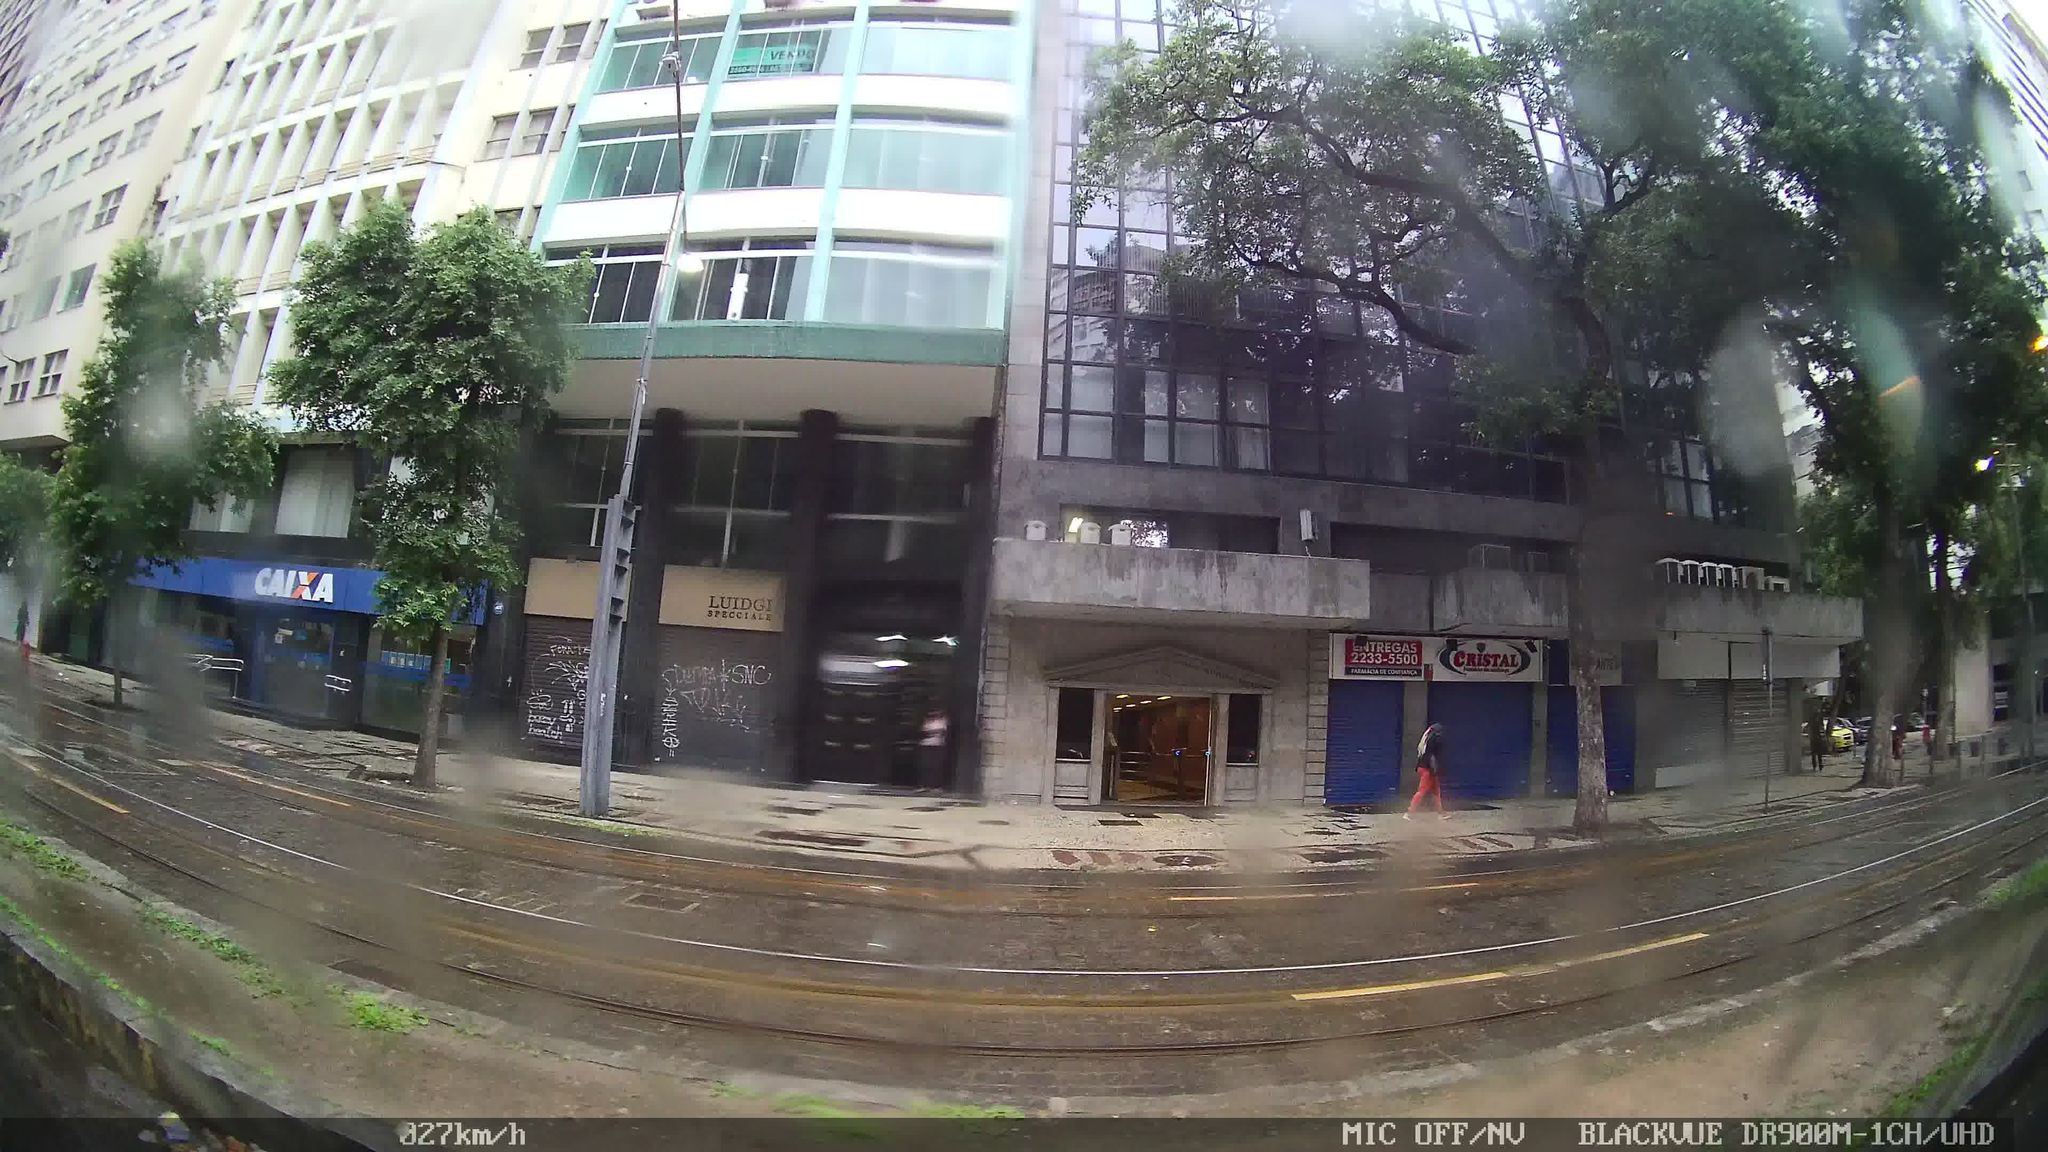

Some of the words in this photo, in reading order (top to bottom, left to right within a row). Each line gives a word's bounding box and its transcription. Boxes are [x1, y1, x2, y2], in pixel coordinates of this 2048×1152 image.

[255, 567, 334, 603] CAIXA
[708, 595, 774, 612] LUIDGI
[707, 610, 772, 621] SPECCIALE
[1353, 641, 1417, 653] ENTREGAS
[1351, 652, 1418, 665] 2233-5500
[1453, 650, 1519, 667] CRISTAL
